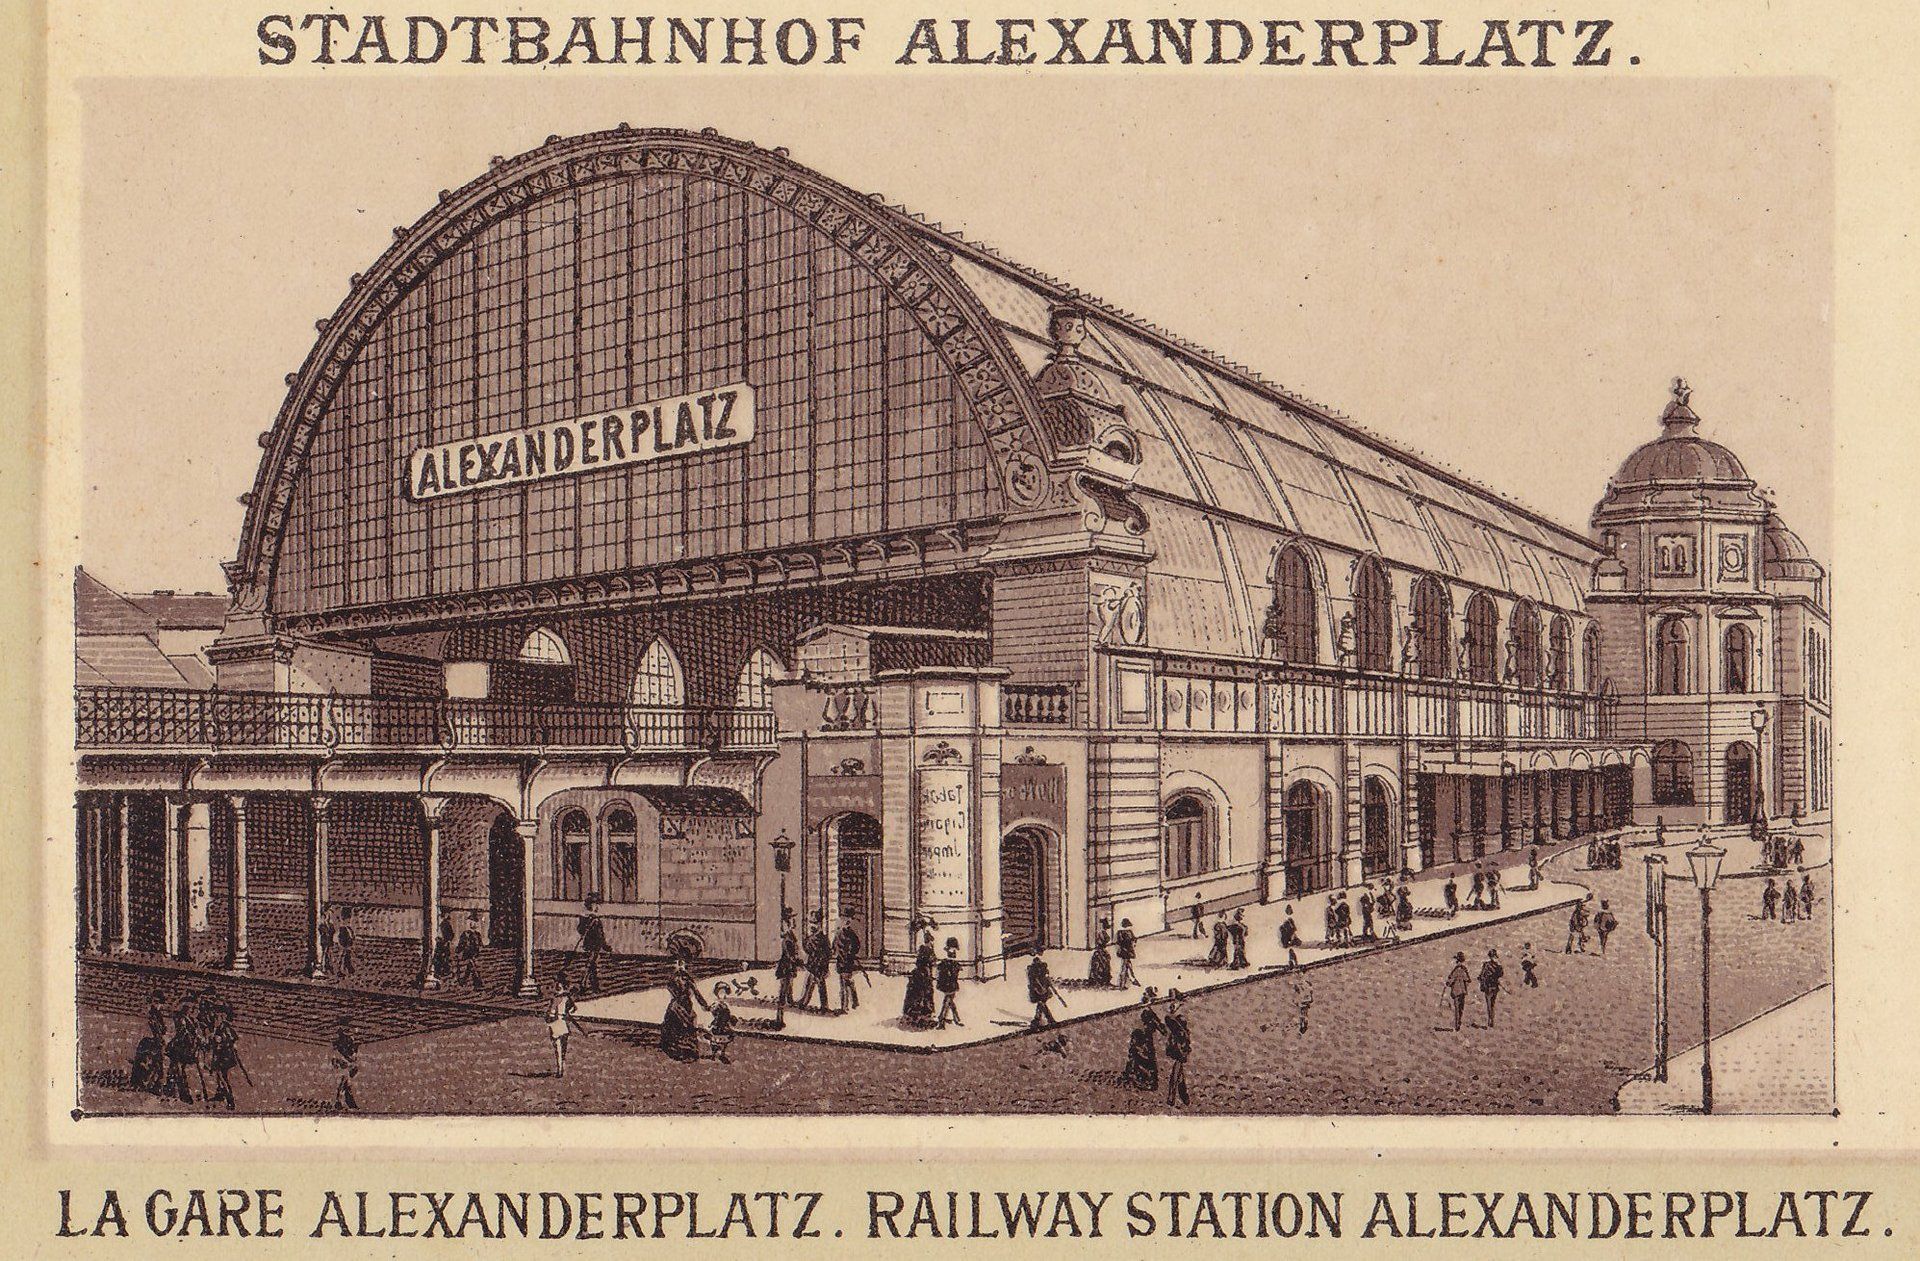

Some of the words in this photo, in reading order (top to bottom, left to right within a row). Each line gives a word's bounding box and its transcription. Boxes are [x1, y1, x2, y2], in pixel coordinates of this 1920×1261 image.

[258, 14, 867, 68] STADTBAHNHOF
[896, 18, 1642, 69] ALEXANDERPLATZ.
[415, 390, 738, 497] ALEXANDERPLATZ
[57, 1191, 131, 1239] LA
[145, 1190, 285, 1239] GARE
[309, 1191, 844, 1241] ALEXANDERPLATZ.
[867, 1191, 1115, 1240] RAILWAY
[1127, 1192, 1346, 1240] STATION
[1361, 1191, 1894, 1241] ALEXANDERPLATZ.
